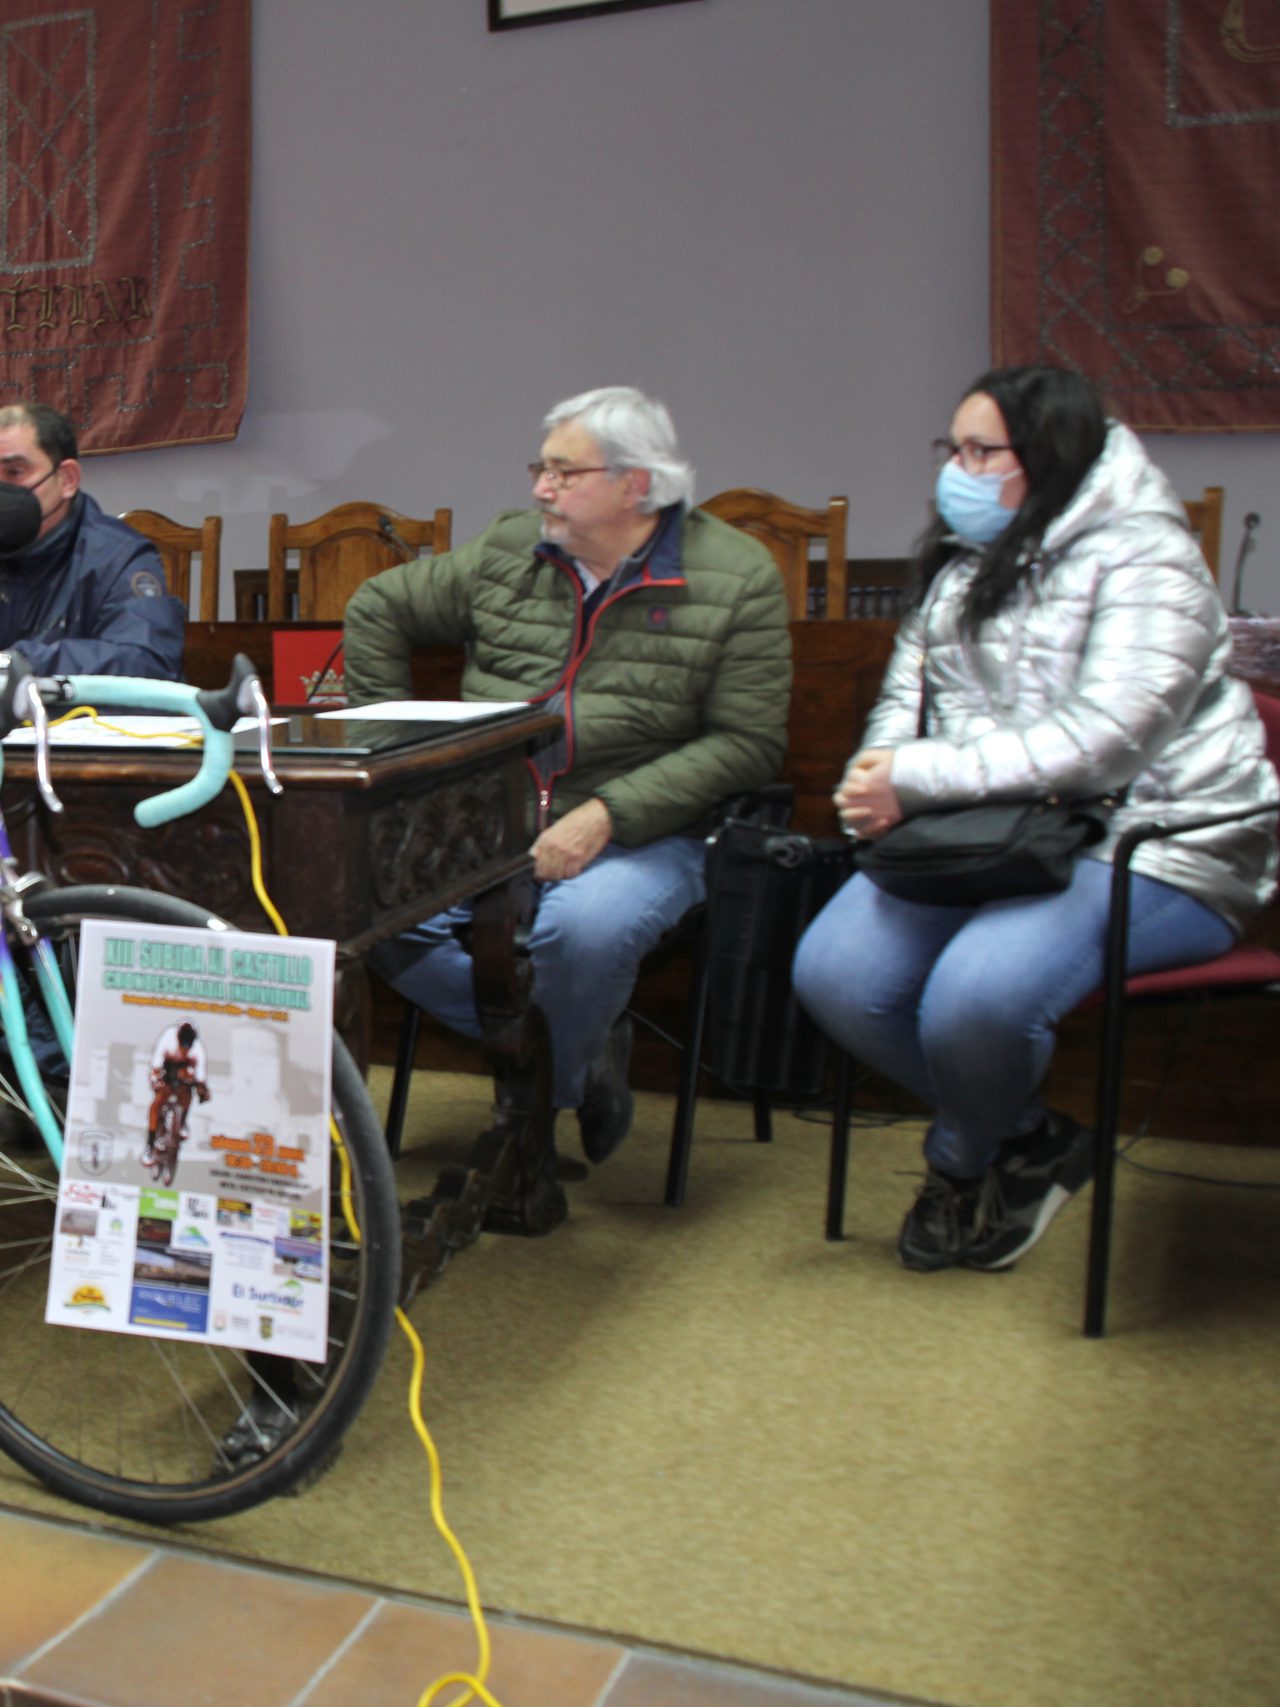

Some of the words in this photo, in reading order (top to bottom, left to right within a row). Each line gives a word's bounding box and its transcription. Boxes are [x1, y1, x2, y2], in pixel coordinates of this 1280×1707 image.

[139, 940, 204, 975] SUBIDA
[207, 945, 227, 977] AL
[231, 948, 313, 986] CASTILLO
